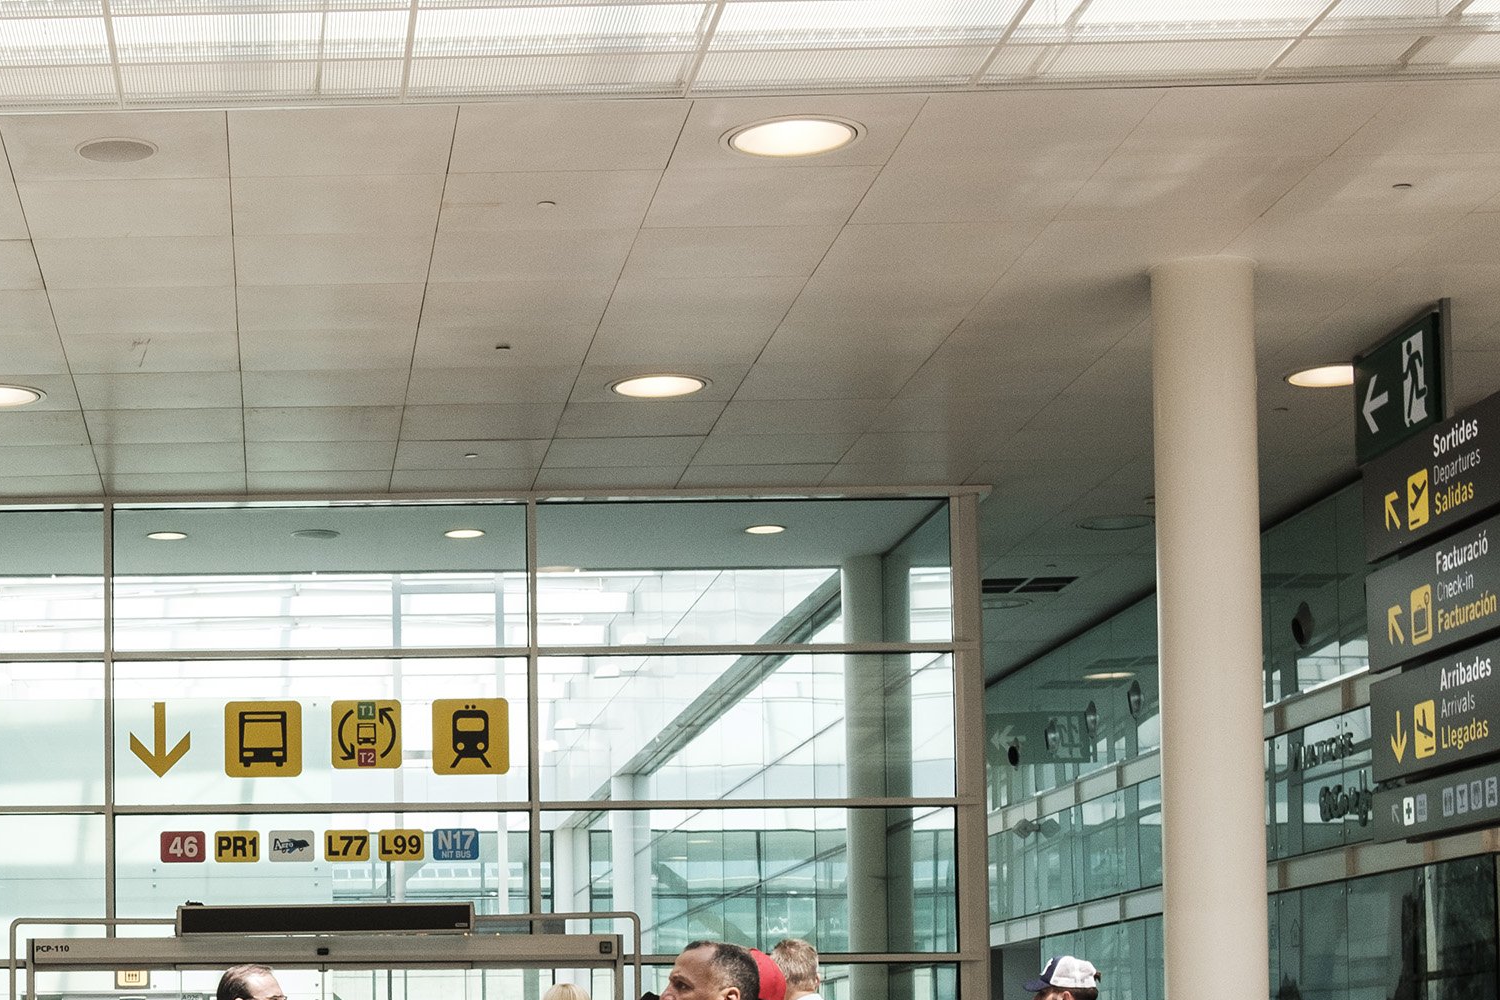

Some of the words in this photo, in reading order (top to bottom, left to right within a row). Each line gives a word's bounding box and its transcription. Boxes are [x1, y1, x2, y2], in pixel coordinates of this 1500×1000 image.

[1433, 419, 1478, 458] Sortides
[1433, 448, 1481, 485] Departures
[1435, 481, 1474, 515] Salidas
[1435, 529, 1488, 575] Facturació
[1437, 571, 1474, 602] Check-in
[1437, 590, 1497, 634] Facturación
[1440, 656, 1492, 692] Arribades
[360, 705, 374, 716] T1
[1441, 690, 1476, 719] Arrivals
[1441, 717, 1489, 751] Llegadas
[359, 752, 375, 763] T2
[168, 836, 199, 858] 46
[217, 836, 257, 857] PR1
[327, 835, 367, 857] L77
[381, 835, 421, 855] L99
[437, 830, 475, 850] N17
[441, 850, 453, 859] NIT
[455, 850, 472, 859] BUS
[35, 945, 70, 953] PCP-110
